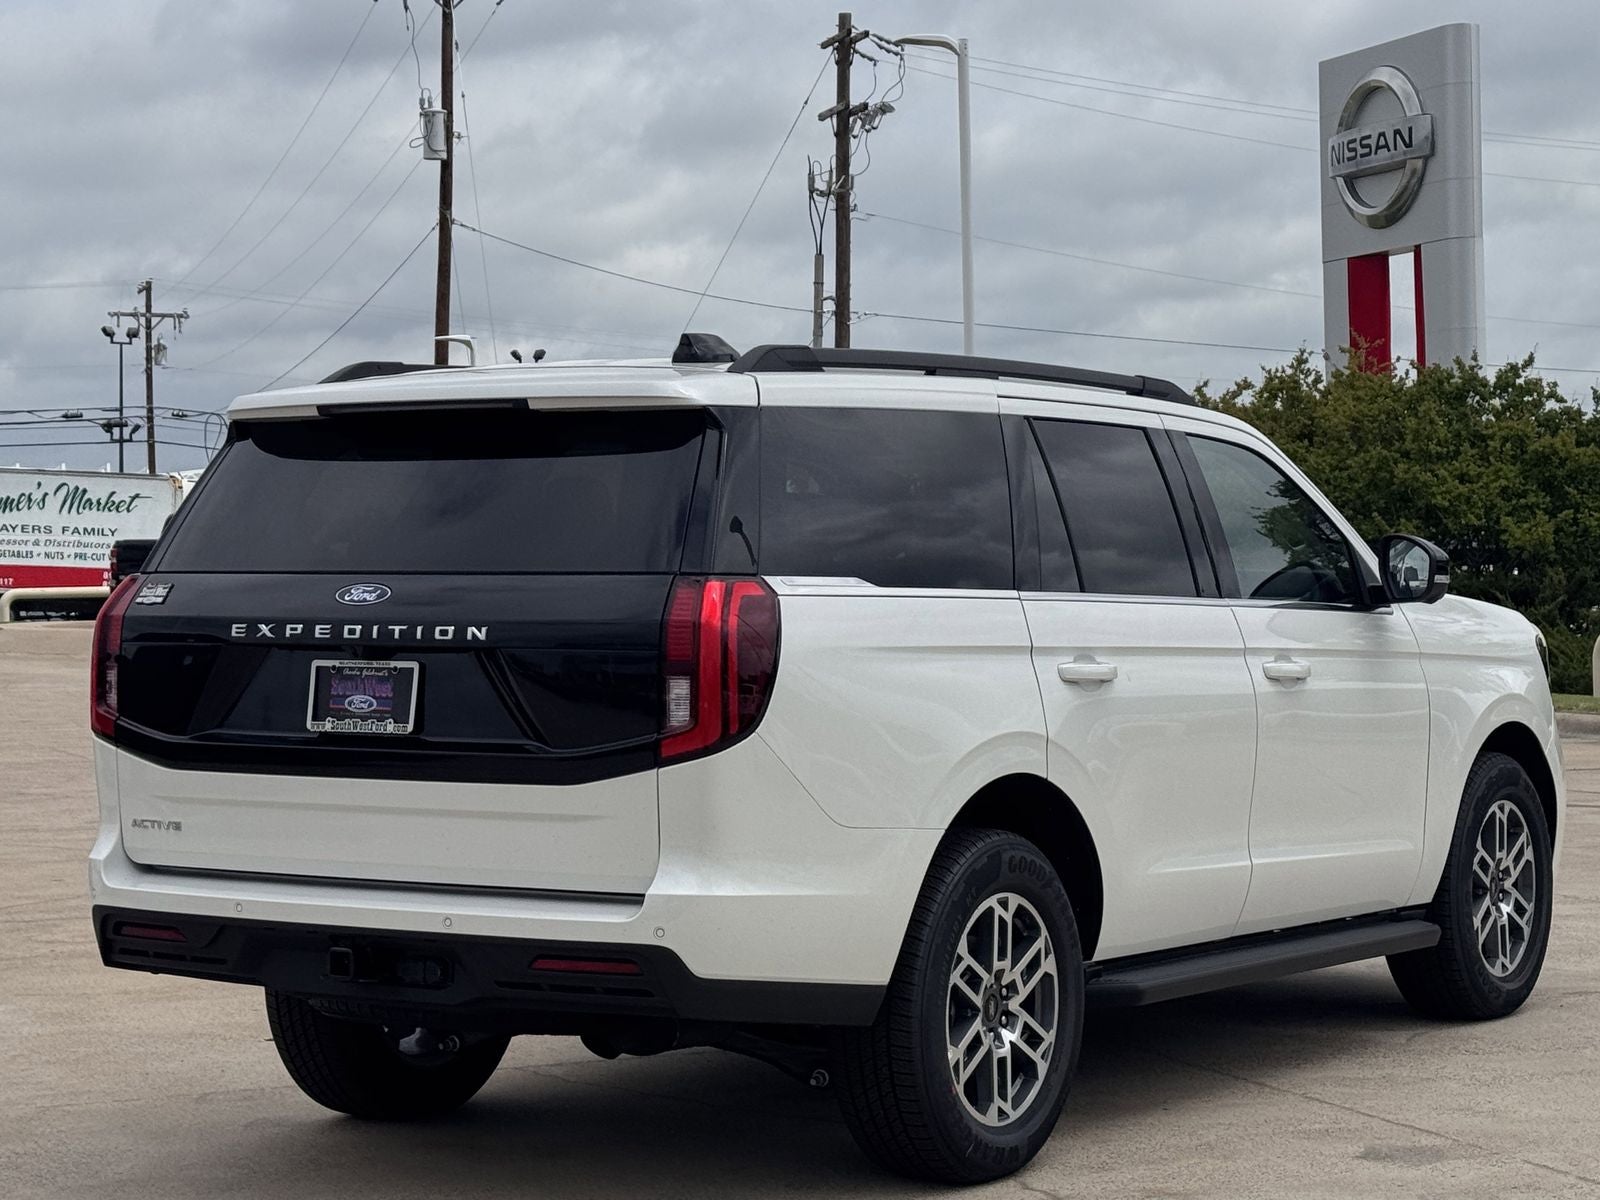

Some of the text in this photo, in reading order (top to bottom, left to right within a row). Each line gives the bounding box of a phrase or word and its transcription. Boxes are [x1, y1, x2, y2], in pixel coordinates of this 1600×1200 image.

[1331, 126, 1413, 167] NISSAN
[53, 482, 152, 515] Market
[61, 525, 118, 537] FAMILY
[32, 538, 41, 547] &
[43, 539, 111, 550] Distributors
[44, 551, 65, 561] NUTS
[74, 552, 106, 562] PRE-CUT
[344, 586, 381, 601] Ford
[230, 623, 489, 641] EXPEDITION
[131, 818, 182, 832] ACTIVE
